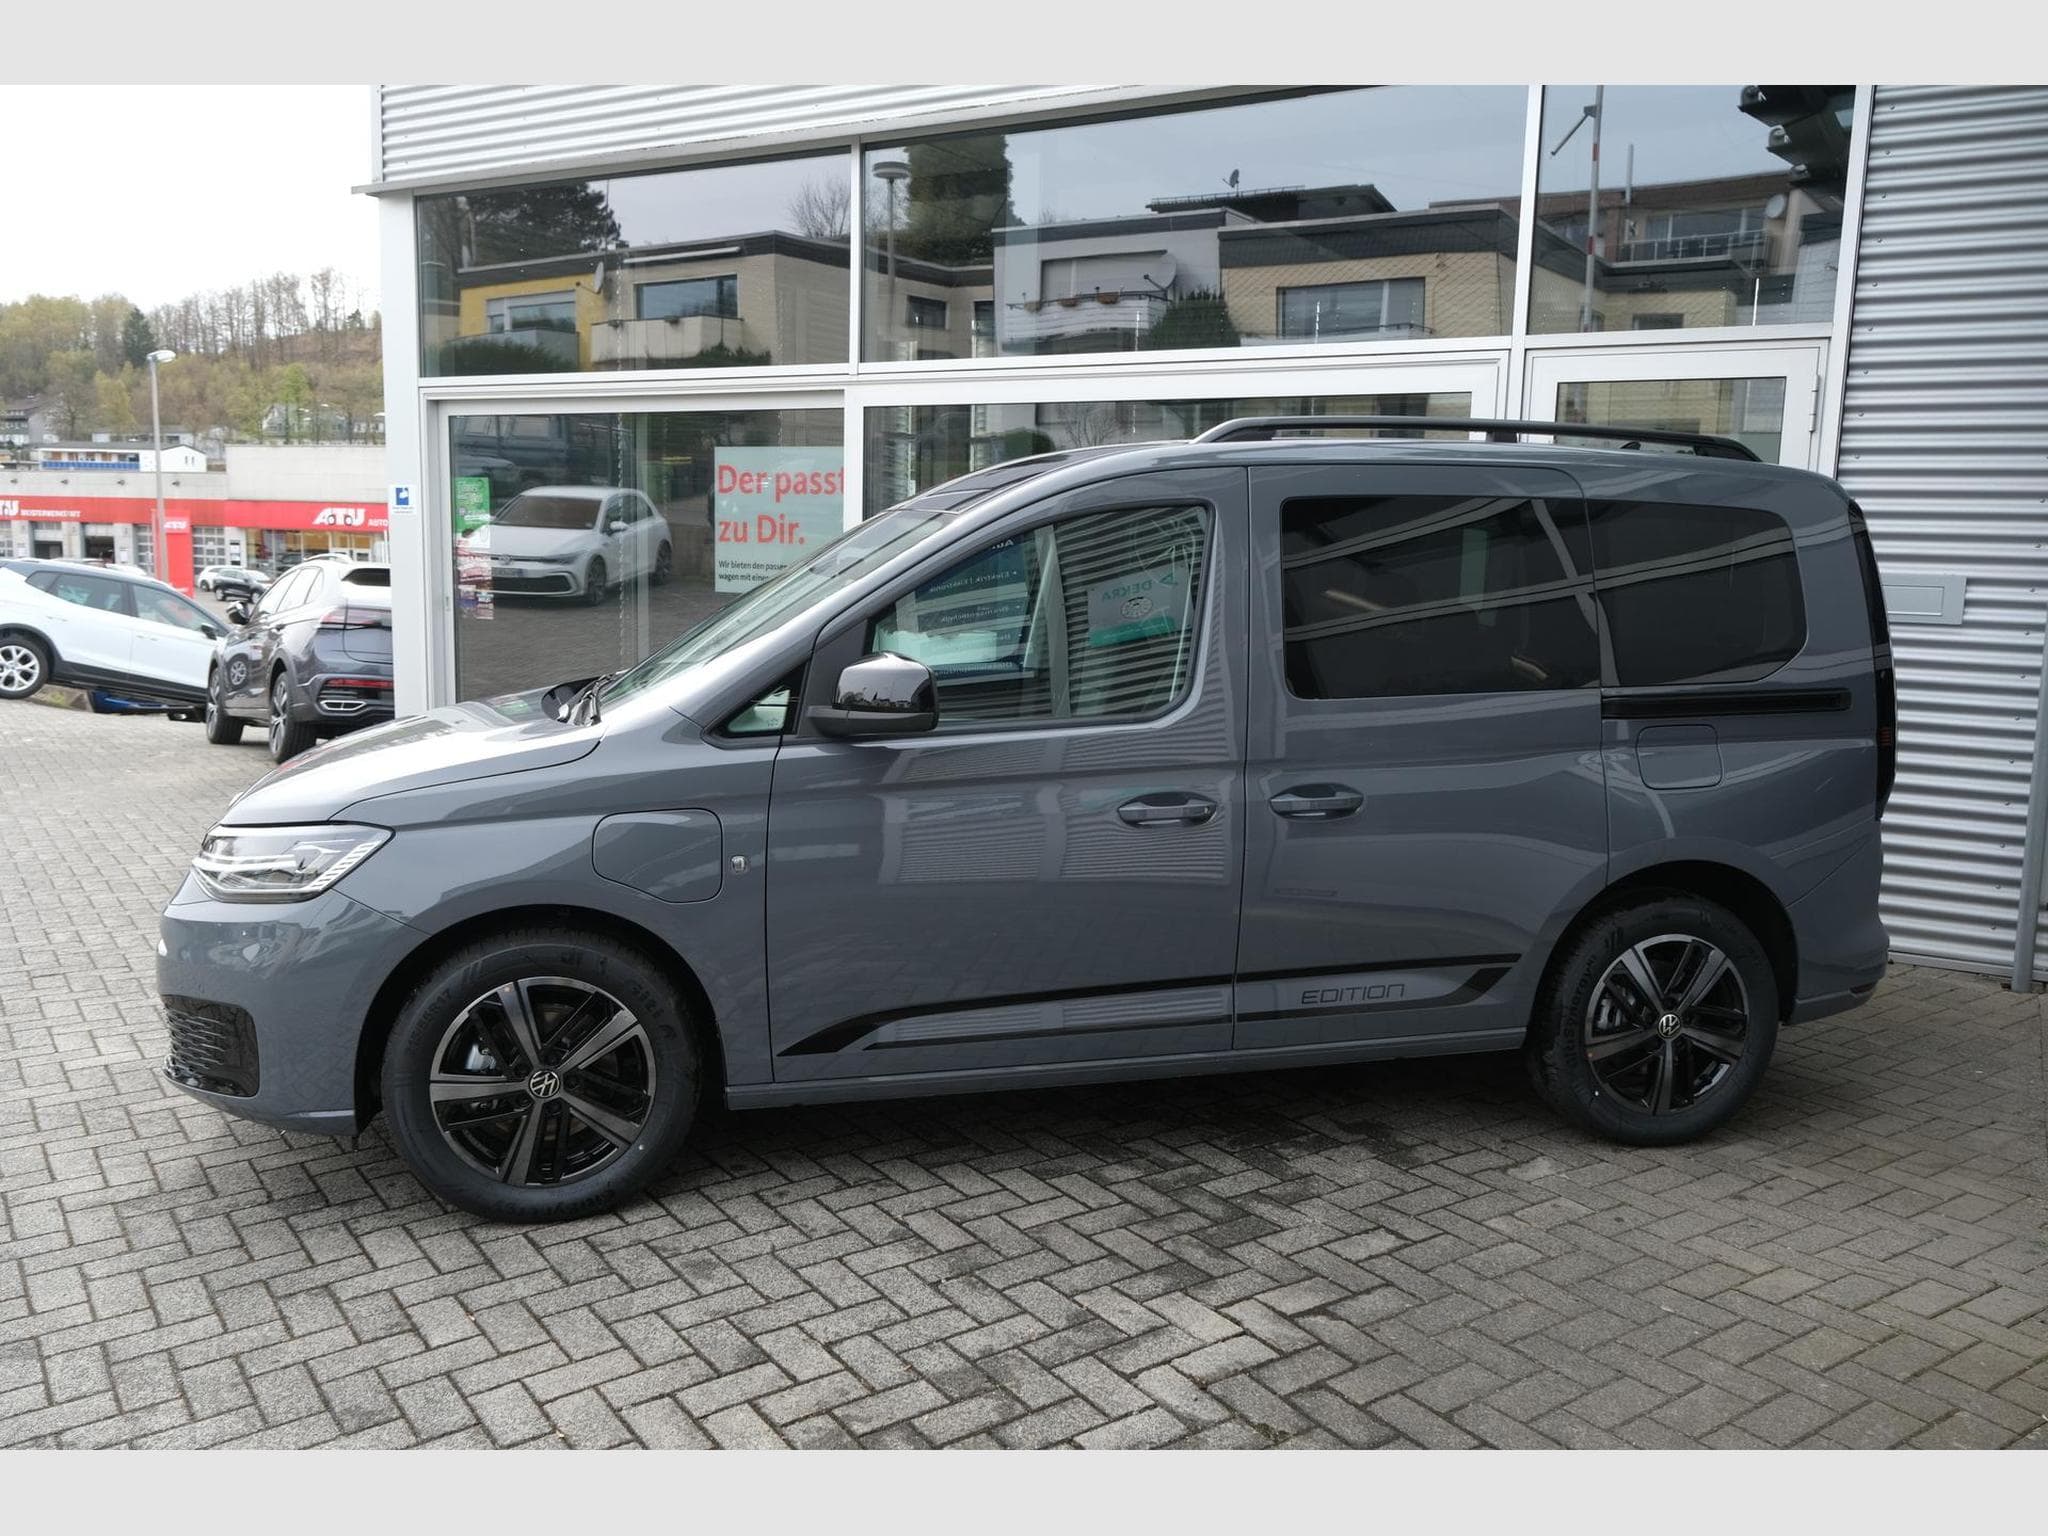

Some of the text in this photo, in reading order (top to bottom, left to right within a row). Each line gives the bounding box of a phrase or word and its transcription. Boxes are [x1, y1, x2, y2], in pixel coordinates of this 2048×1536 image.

[718, 464, 768, 494] Der
[312, 507, 366, 527] ATU
[718, 513, 805, 545] zu Dir.
[718, 560, 731, 569] Wir
[731, 560, 752, 570] bieten
[752, 562, 765, 570] den
[718, 574, 739, 583] wagen
[740, 573, 751, 582] mit
[1301, 983, 1406, 1005] EDITION
